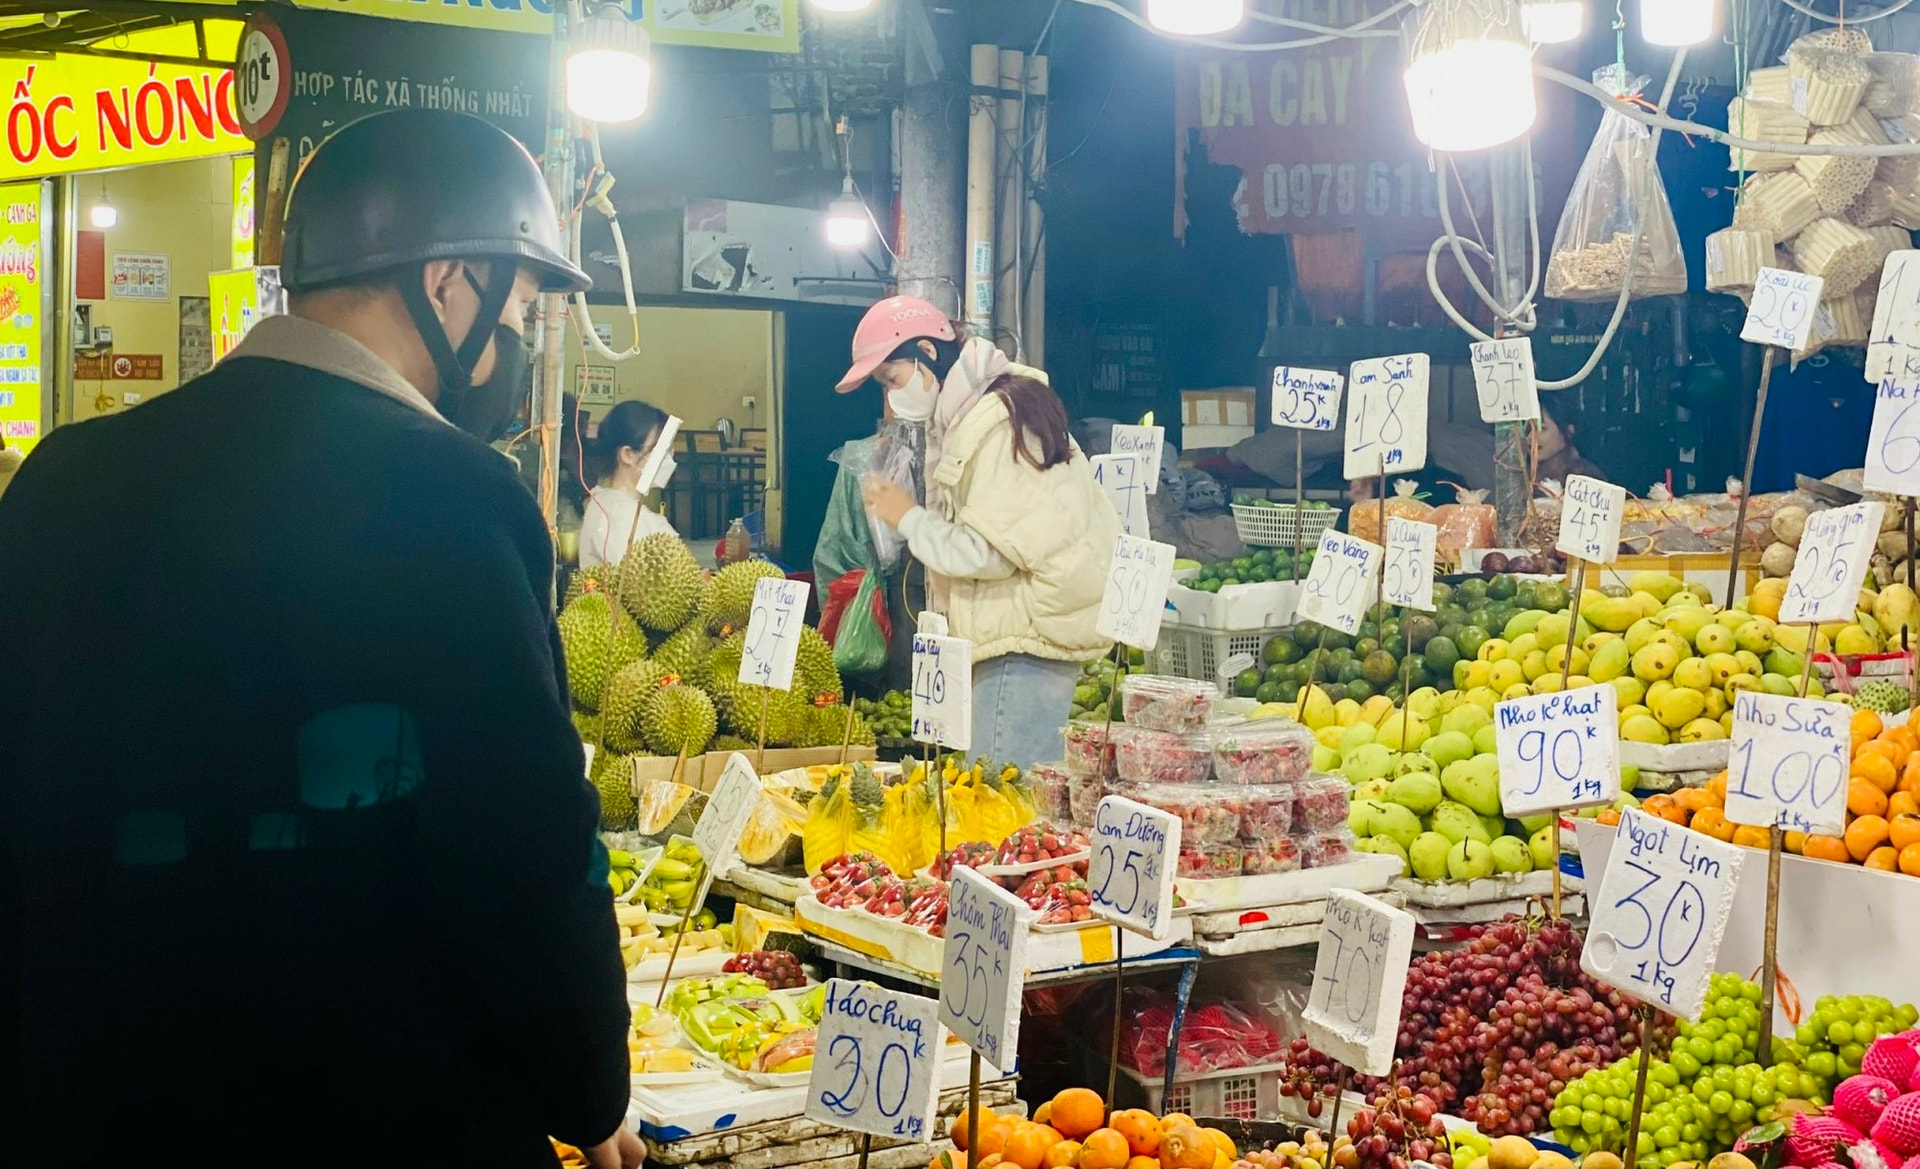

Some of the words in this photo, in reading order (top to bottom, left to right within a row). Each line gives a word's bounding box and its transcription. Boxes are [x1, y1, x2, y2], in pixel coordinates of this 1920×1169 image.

[8, 66, 78, 163] ỐC
[294, 71, 334, 105] HỢP
[343, 70, 378, 104] TÁC
[385, 76, 411, 107] XÃ
[417, 75, 479, 112] THỐNG
[485, 81, 533, 118] NHẤT
[1263, 162, 1354, 219] 0978
[1782, 702, 1835, 738] Sữa
[1096, 802, 1122, 839] Cam
